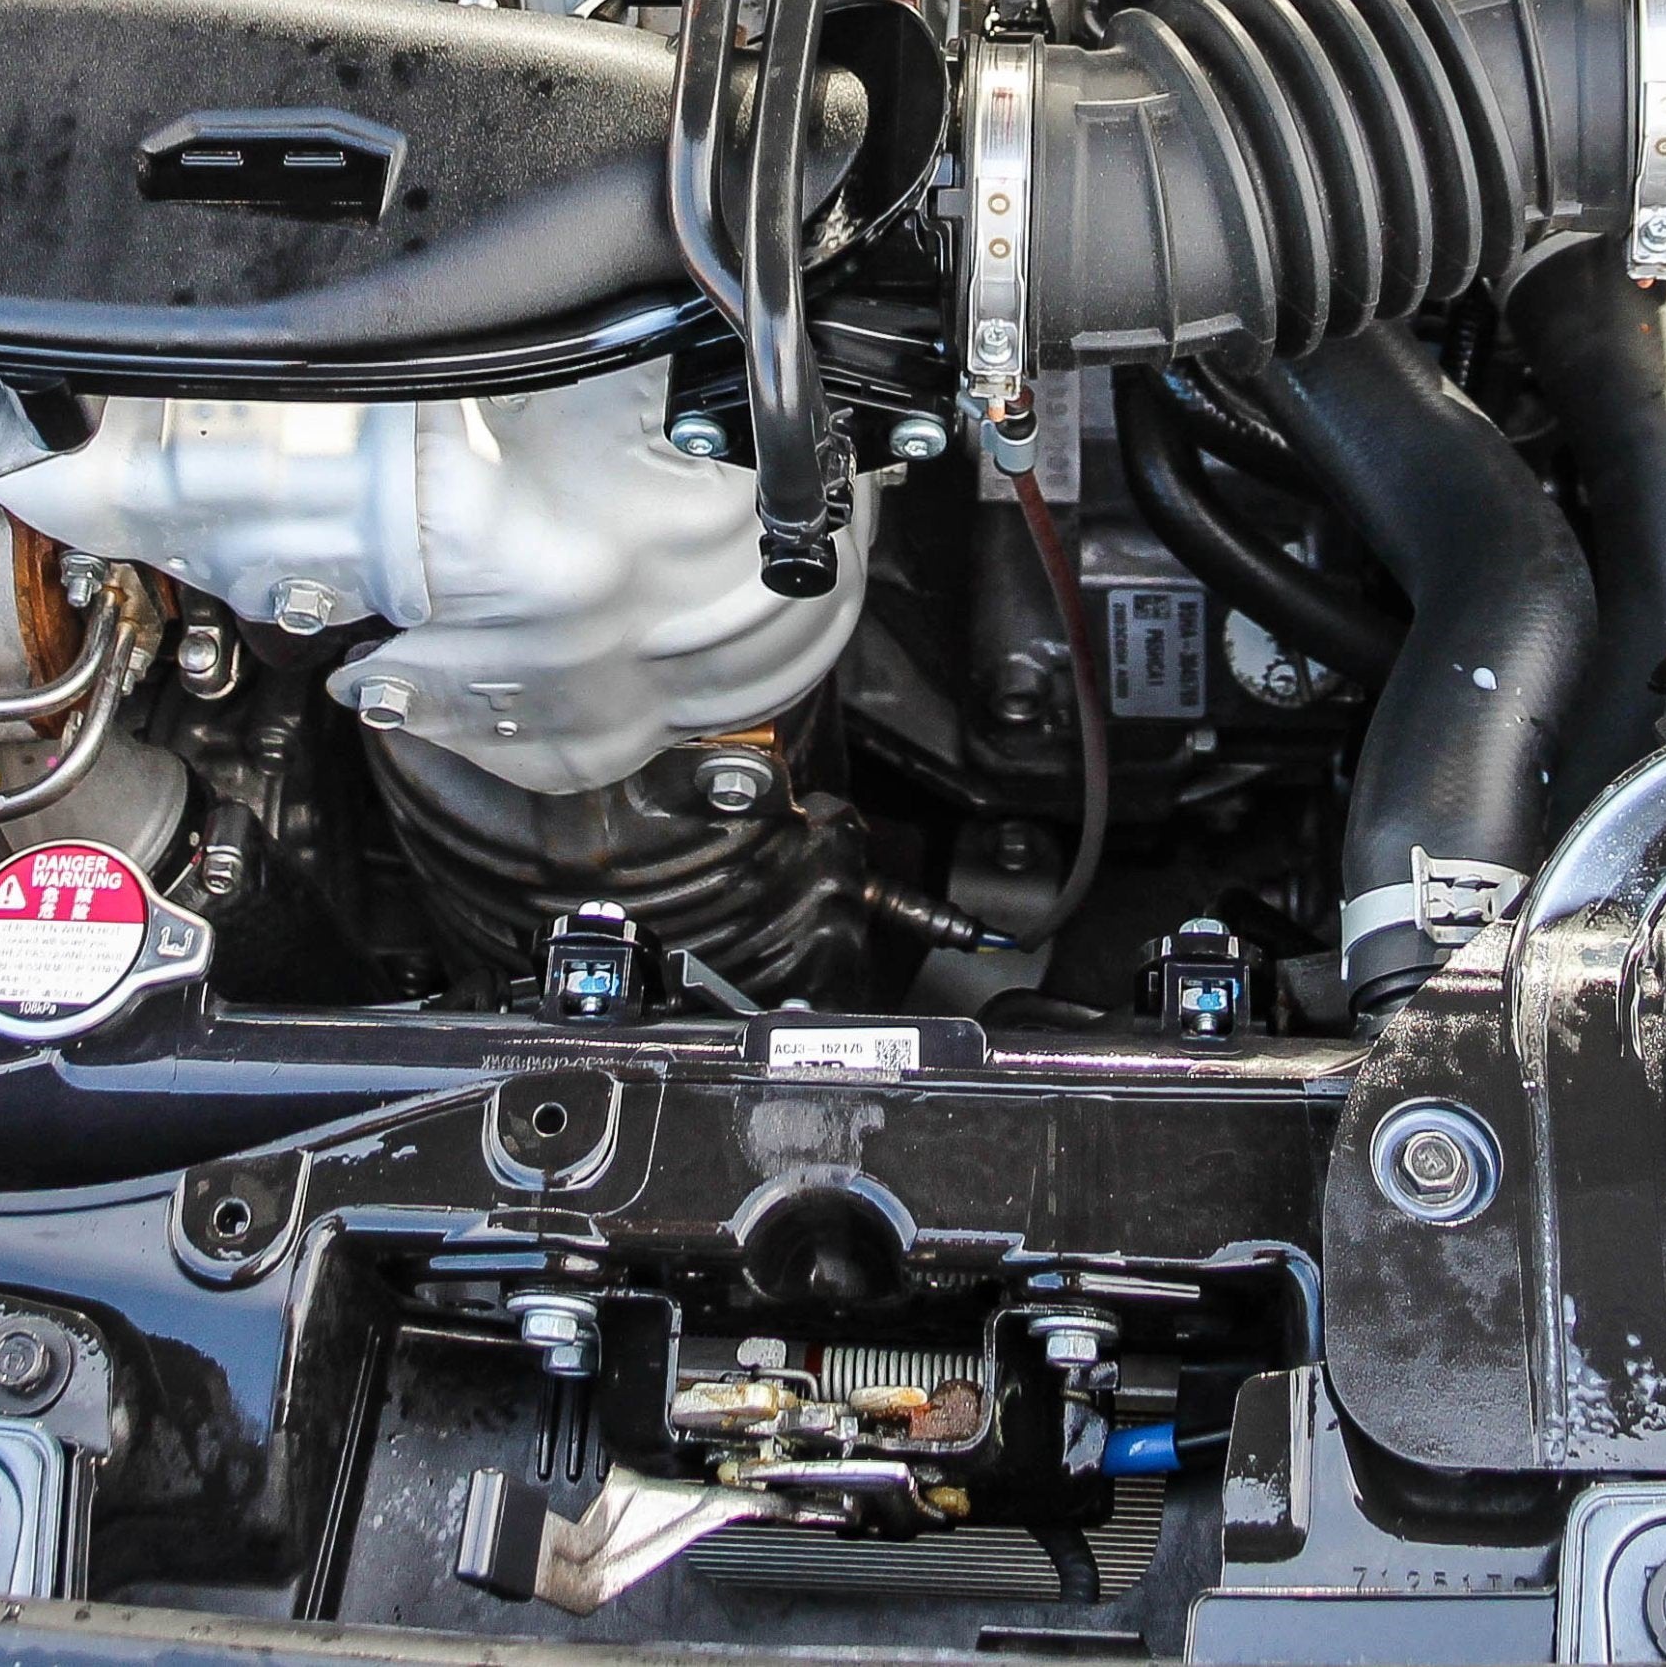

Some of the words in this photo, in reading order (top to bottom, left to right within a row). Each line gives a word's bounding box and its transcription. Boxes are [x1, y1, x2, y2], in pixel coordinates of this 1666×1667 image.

[33, 853, 109, 871] DANGER
[31, 870, 123, 890] WARNUNG
[19, 1000, 58, 1015] 108kPa
